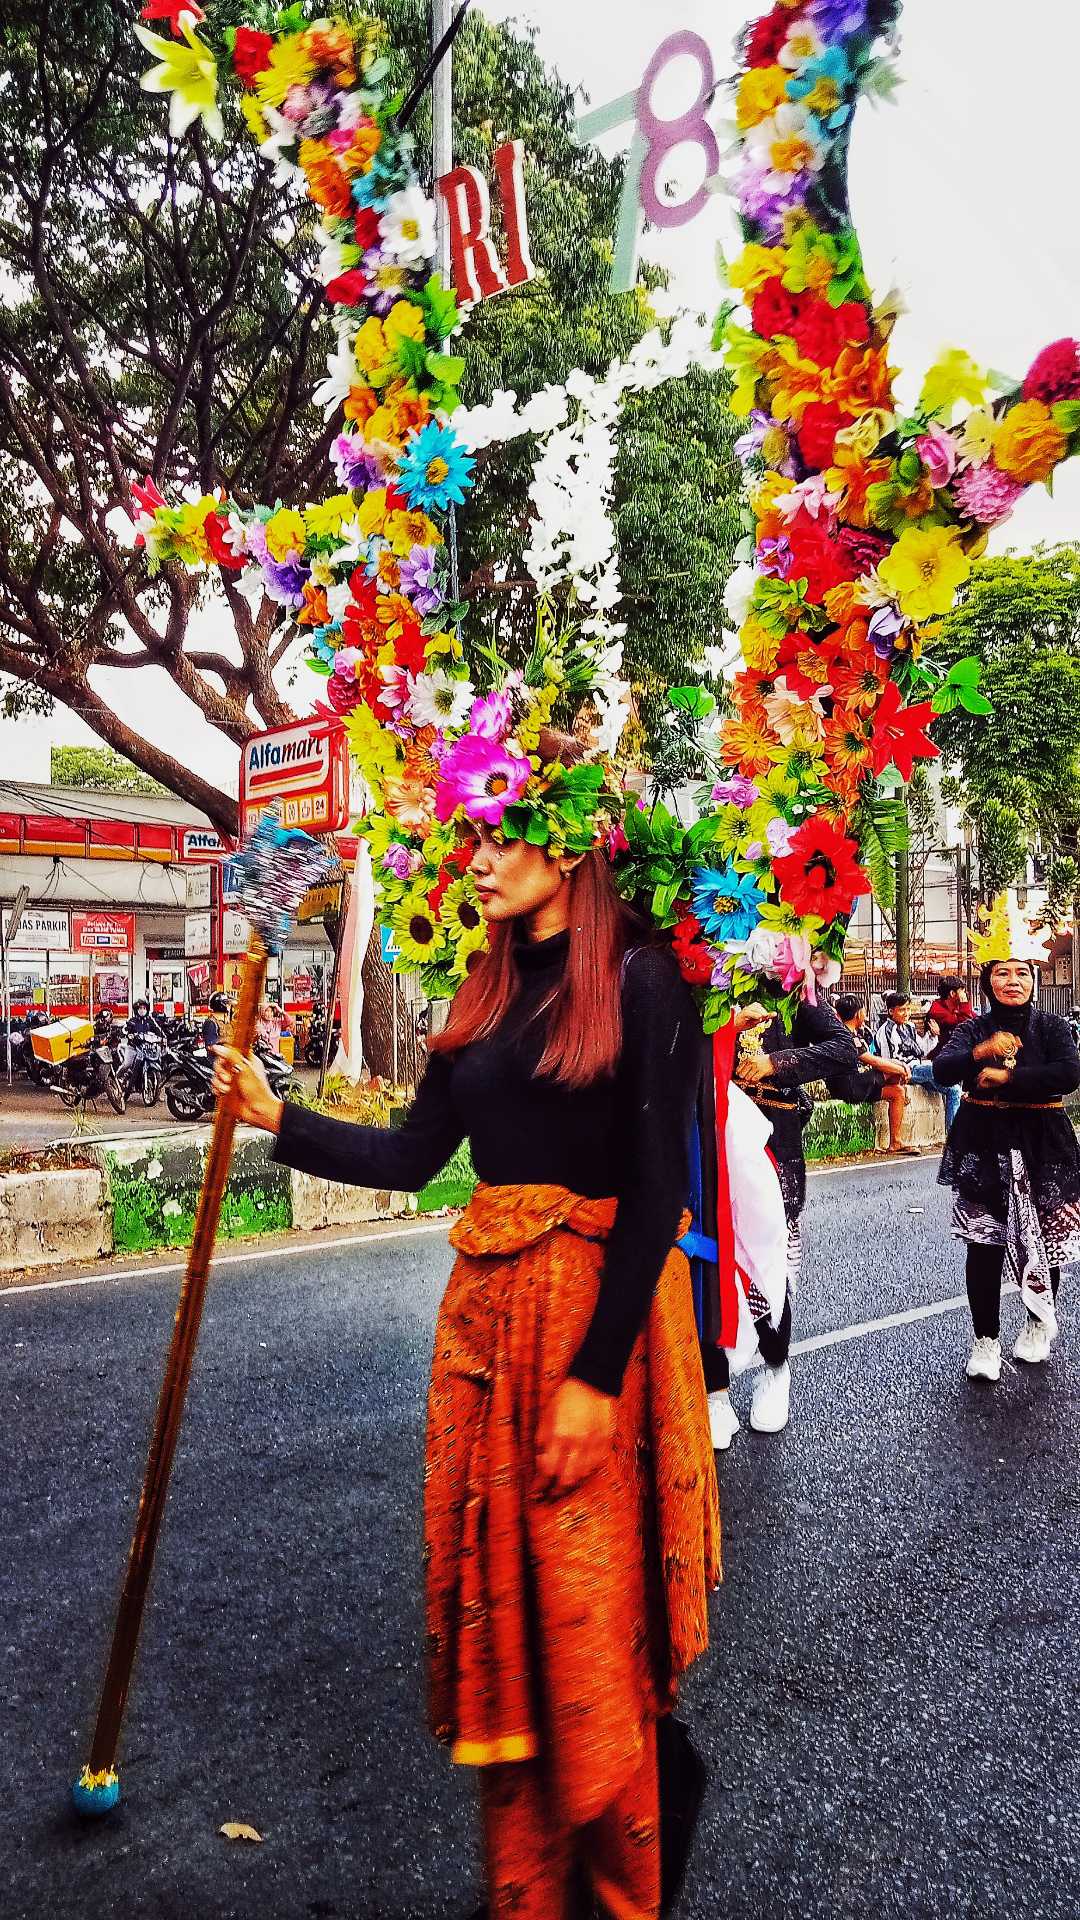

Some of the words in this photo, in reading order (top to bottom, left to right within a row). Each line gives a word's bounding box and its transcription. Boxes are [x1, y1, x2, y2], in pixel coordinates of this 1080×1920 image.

[436, 138, 536, 312] RI
[574, 29, 720, 296] 78
[249, 736, 323, 771] Alfamart
[315, 800, 325, 811] 24
[187, 833, 225, 848] Alfa
[35, 919, 67, 932] PARKIR
